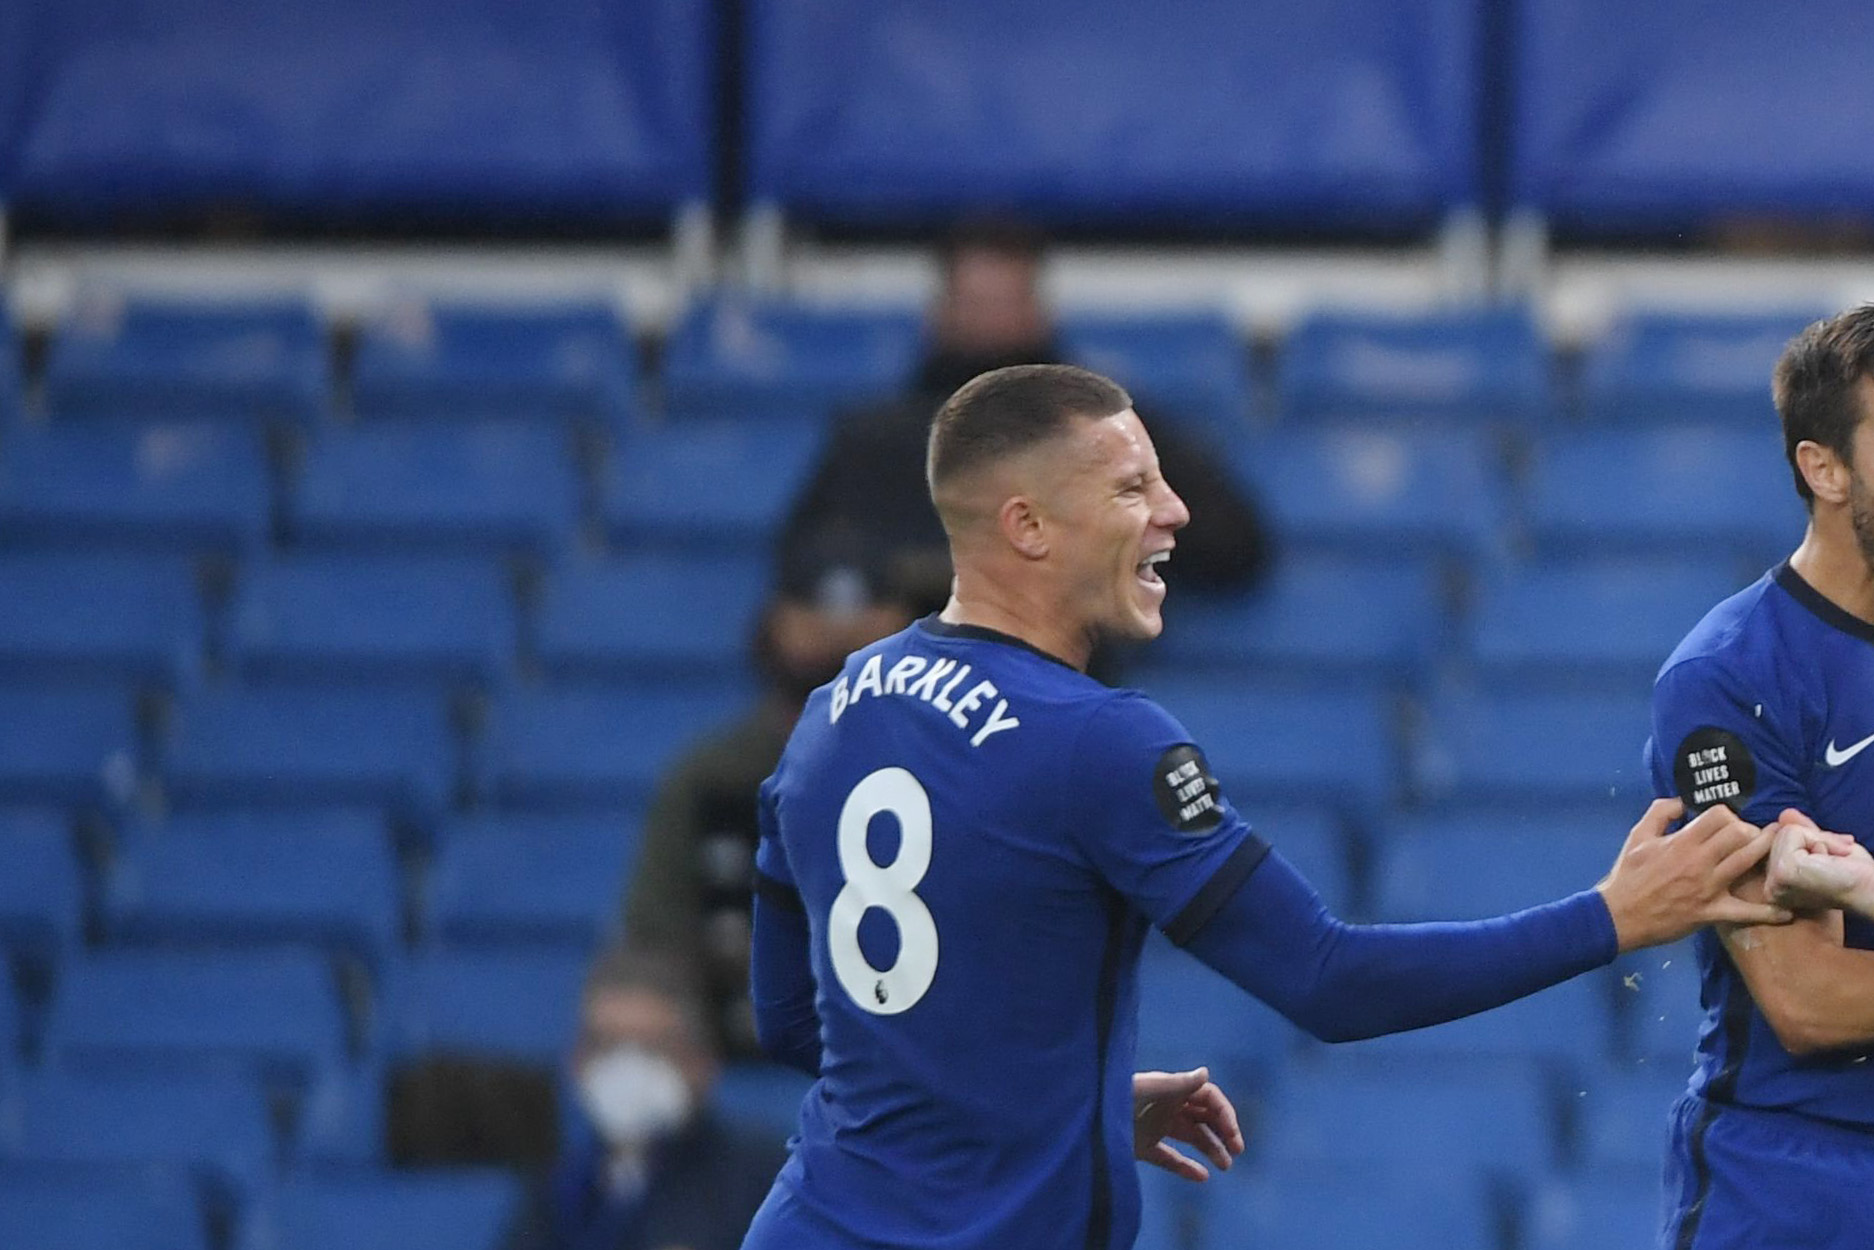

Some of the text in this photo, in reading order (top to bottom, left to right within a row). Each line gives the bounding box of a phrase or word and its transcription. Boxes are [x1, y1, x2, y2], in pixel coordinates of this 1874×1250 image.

[829, 653, 1020, 748] BARKLEY
[1694, 765, 1729, 785] LIVES
[1694, 781, 1740, 804] MATTER
[827, 766, 939, 1015] 8
